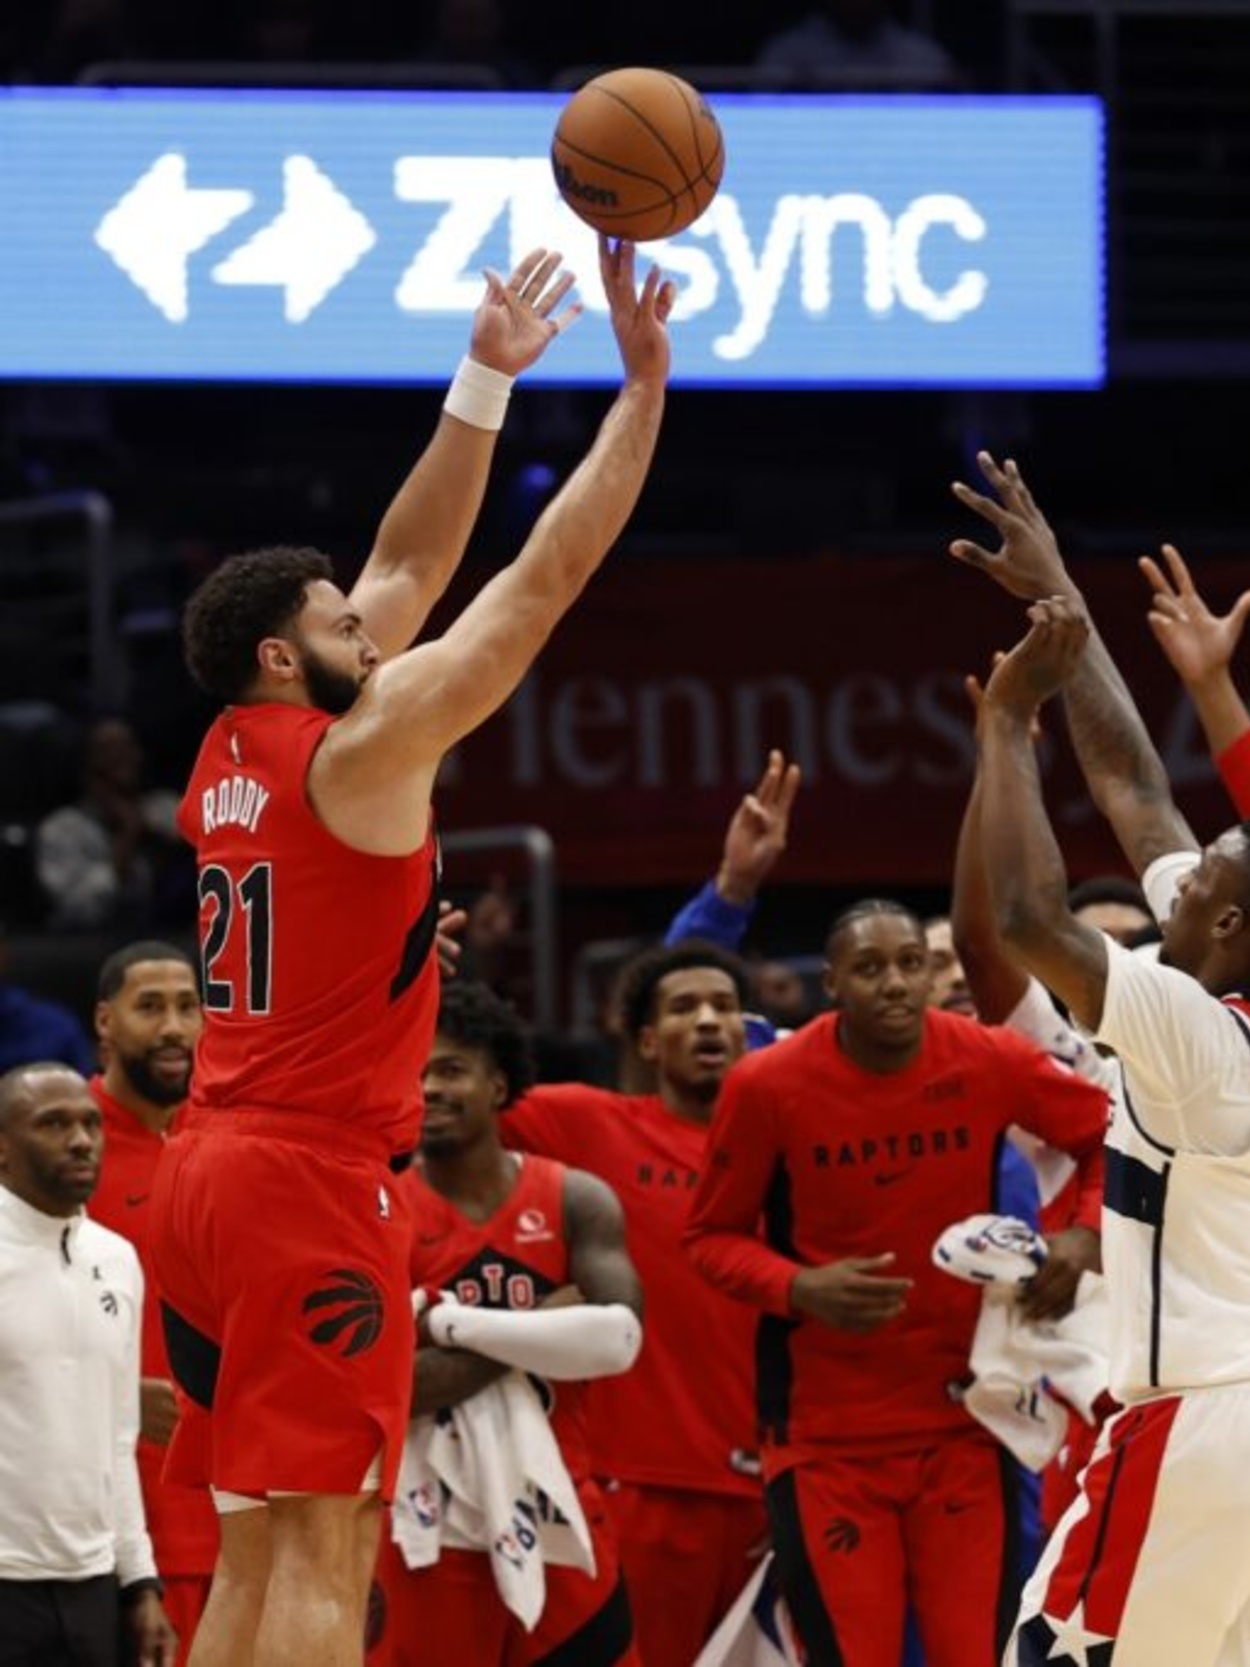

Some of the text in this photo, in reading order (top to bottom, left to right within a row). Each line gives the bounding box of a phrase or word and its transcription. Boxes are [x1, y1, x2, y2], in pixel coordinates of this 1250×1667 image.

[202, 775, 269, 834] RODDY
[198, 862, 272, 1014] 21
[813, 1126, 968, 1168] RAPTORS
